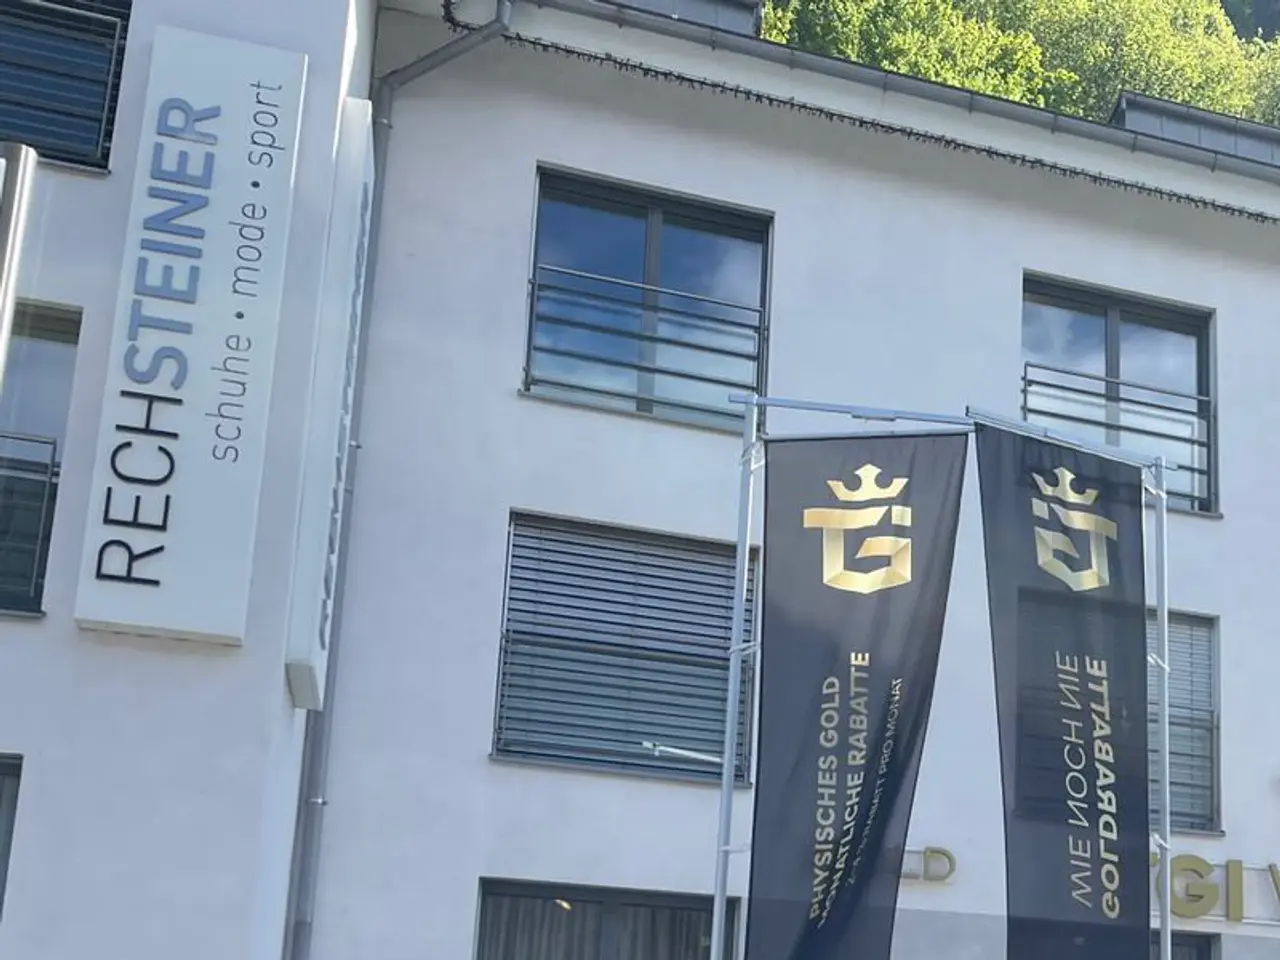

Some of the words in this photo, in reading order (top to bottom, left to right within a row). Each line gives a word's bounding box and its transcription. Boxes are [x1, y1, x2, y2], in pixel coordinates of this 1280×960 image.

[247, 80, 284, 168] sport
[227, 202, 269, 299] mode
[95, 97, 222, 587] RECHSTEINER
[205, 333, 252, 465] schuhe
[819, 675, 840, 749] GOLD
[847, 652, 870, 766] RABATTE
[809, 754, 838, 920] PHYSISCHES
